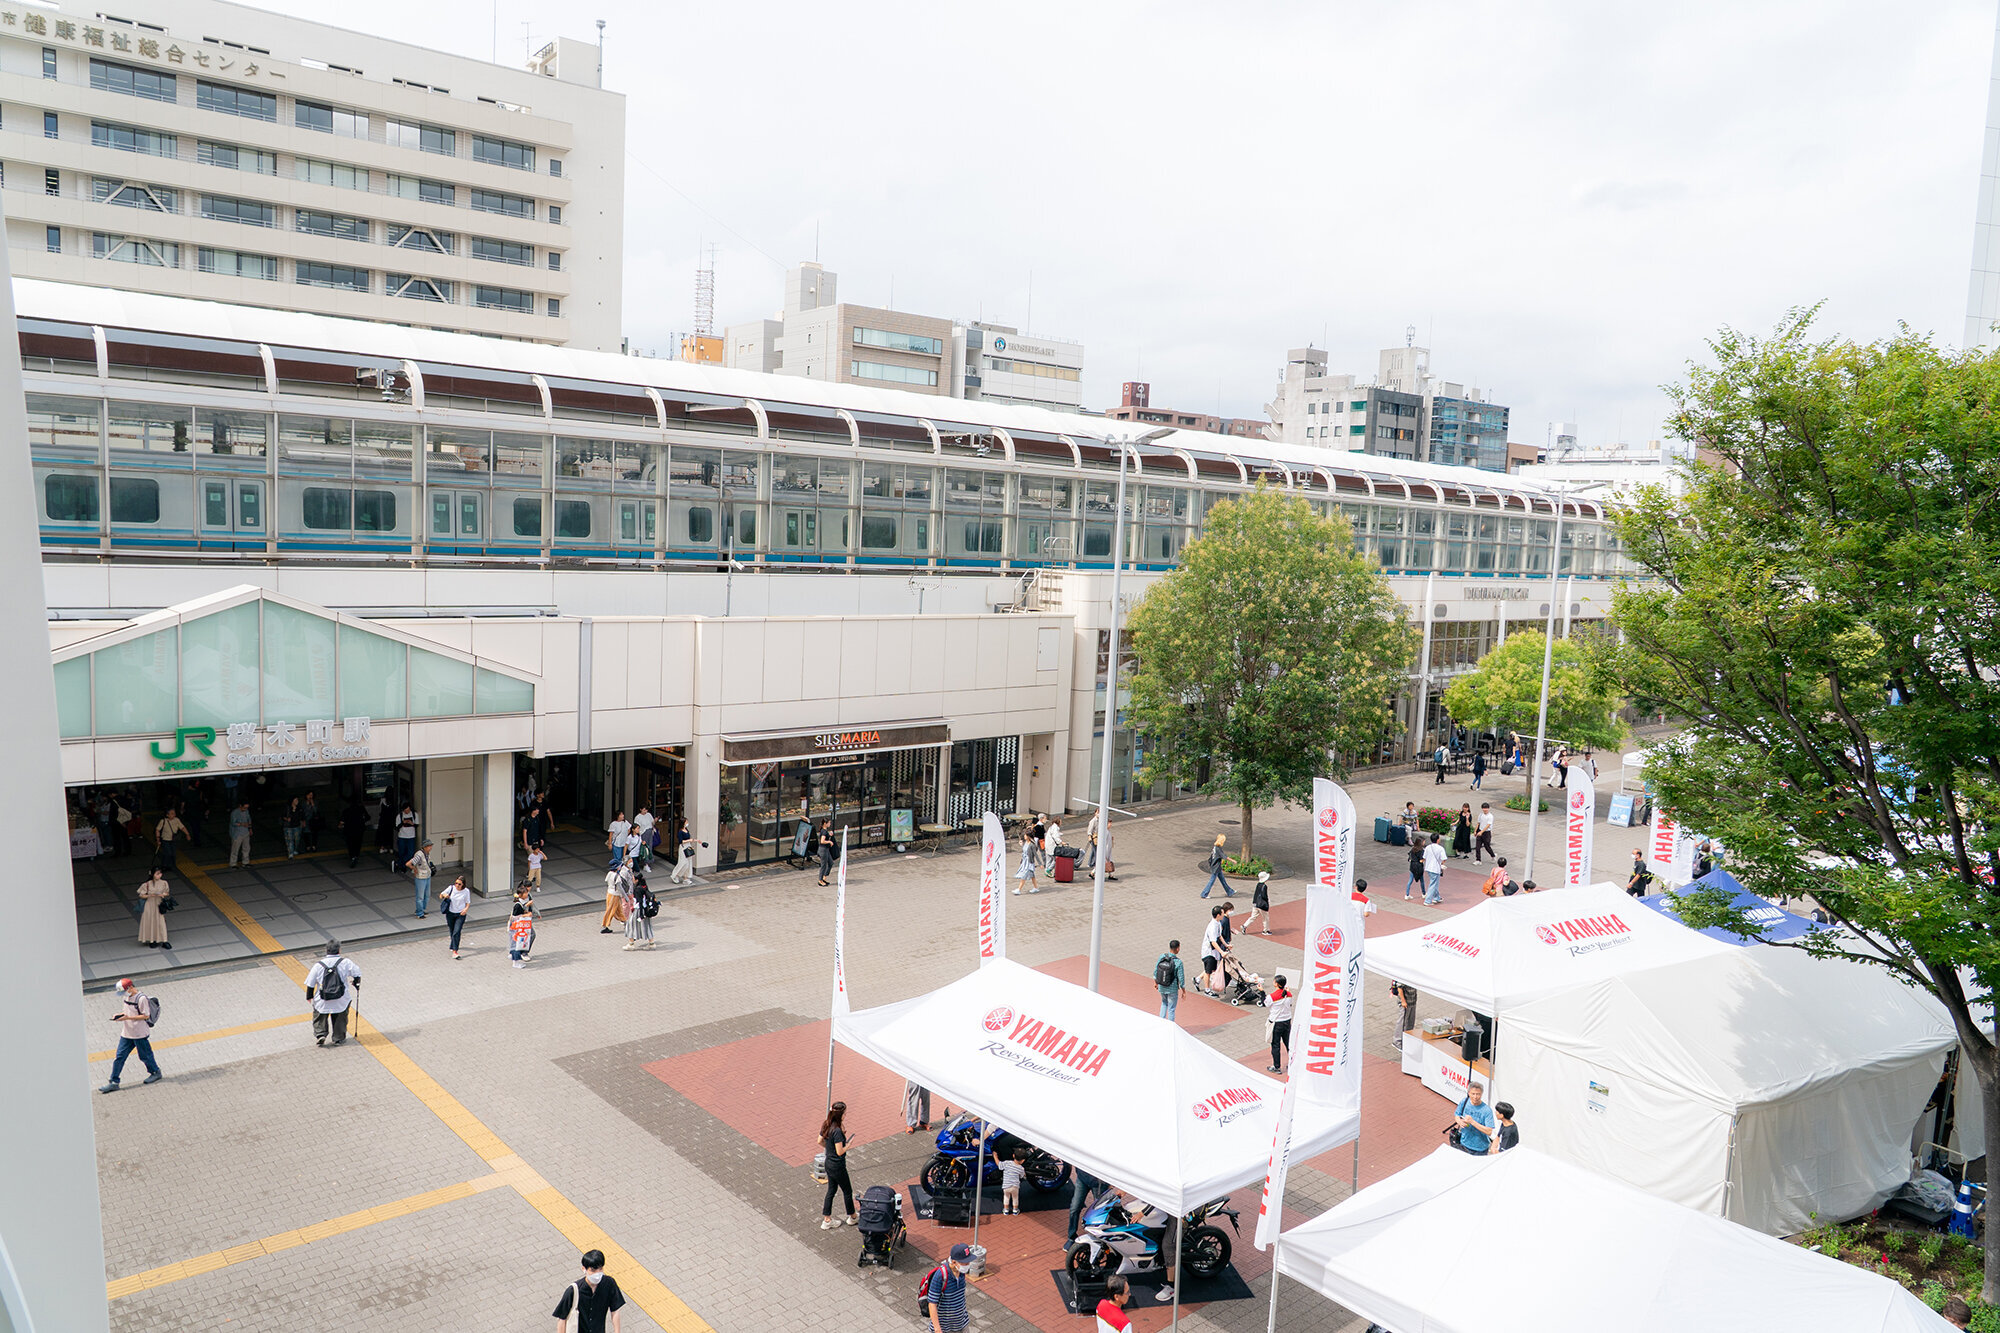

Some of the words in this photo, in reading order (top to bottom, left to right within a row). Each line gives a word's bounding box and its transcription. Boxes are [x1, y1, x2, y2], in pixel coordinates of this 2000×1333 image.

[1008, 343, 1055, 356] HOSHIZAKI
[151, 726, 216, 760] JR
[226, 717, 371, 750] 桜木町駅
[815, 731, 880, 746] SILSMARIA
[321, 745, 370, 760] Station
[1551, 913, 1632, 942] YAMAHA
[1434, 934, 1480, 958] YAMAHA
[1566, 944, 1596, 958] Revs
[1596, 940, 1612, 950] Your
[1612, 935, 1632, 946] Heart
[1008, 1014, 1111, 1077] YAMAHA
[979, 1040, 1024, 1061] Revs
[1015, 1056, 1048, 1073] Your
[1046, 1067, 1081, 1083] Heart
[1449, 1069, 1469, 1089] YAMA
[1205, 1087, 1262, 1112] YAMAHA
[1217, 1110, 1240, 1127] Revs
